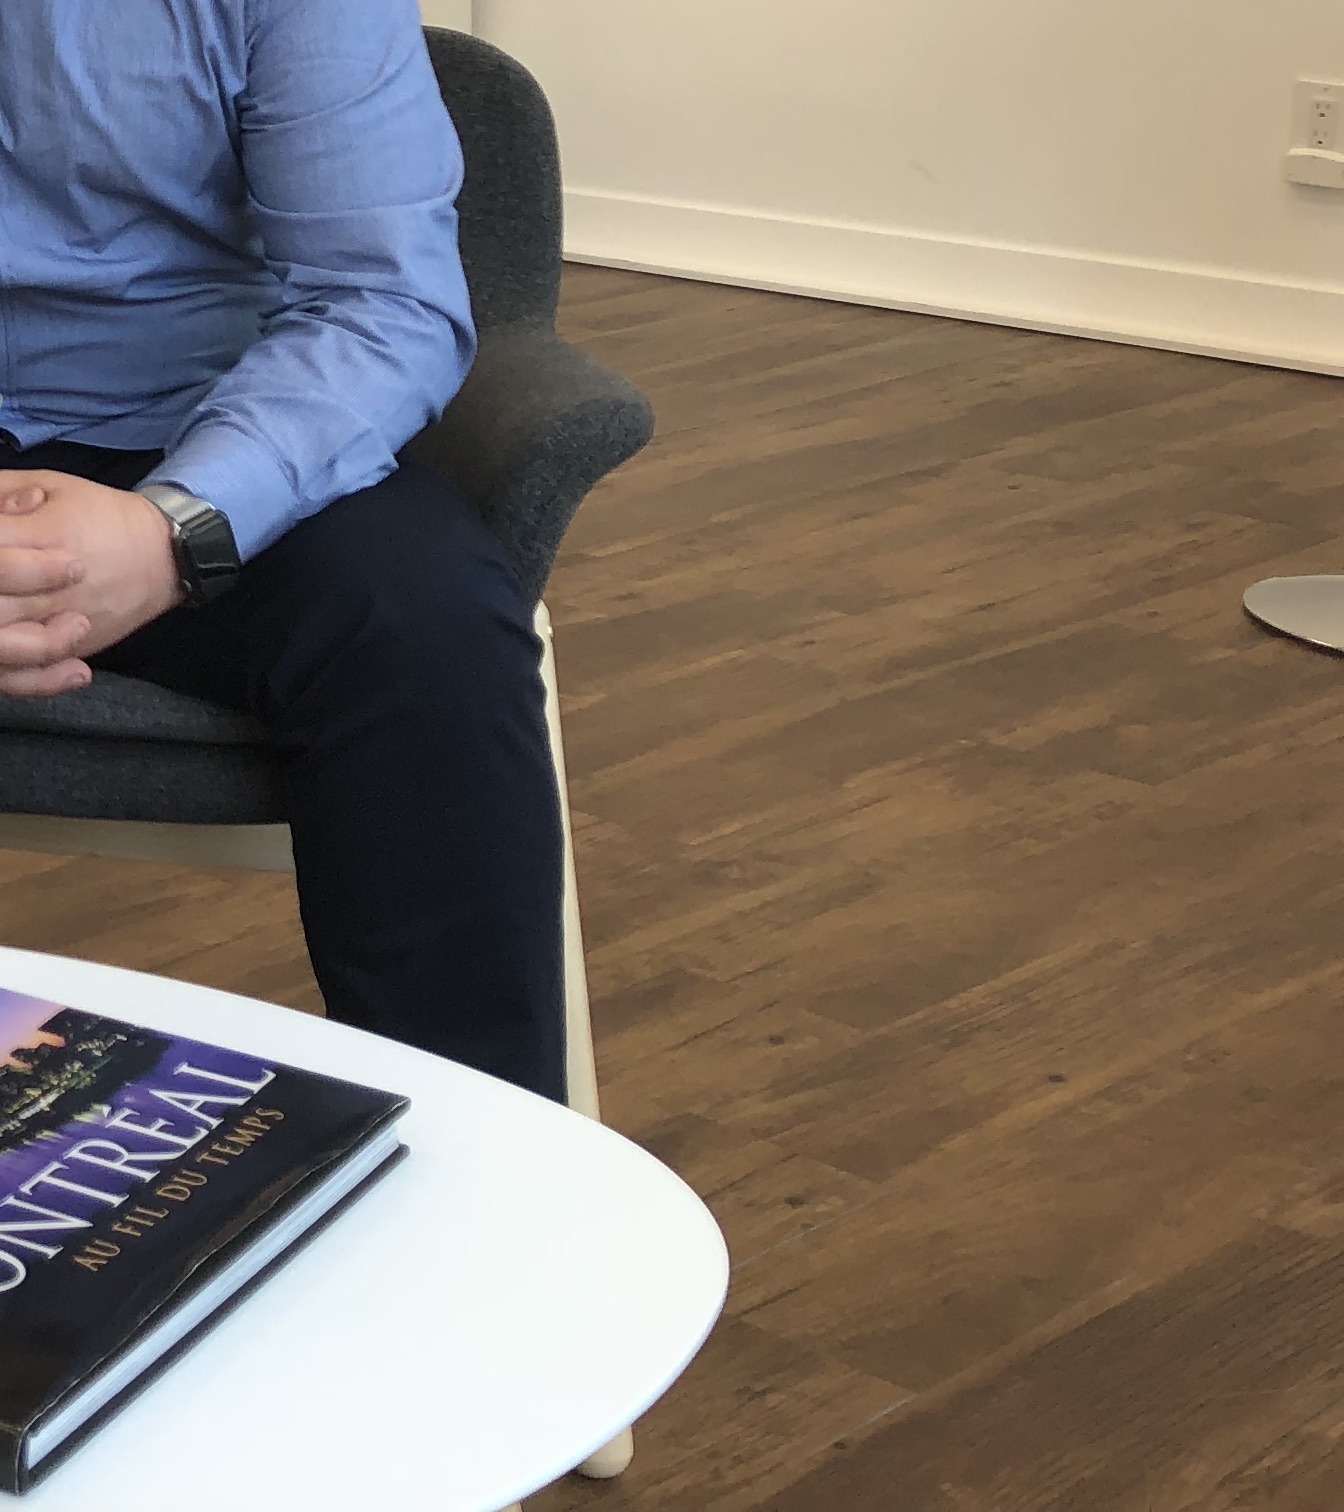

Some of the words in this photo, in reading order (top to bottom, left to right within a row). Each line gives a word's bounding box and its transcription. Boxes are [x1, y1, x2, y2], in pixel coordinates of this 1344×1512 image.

[73, 1239, 121, 1272] AU
[112, 1206, 170, 1237] FIL
[155, 1168, 208, 1202] DU
[196, 1107, 285, 1166] TEMPS
